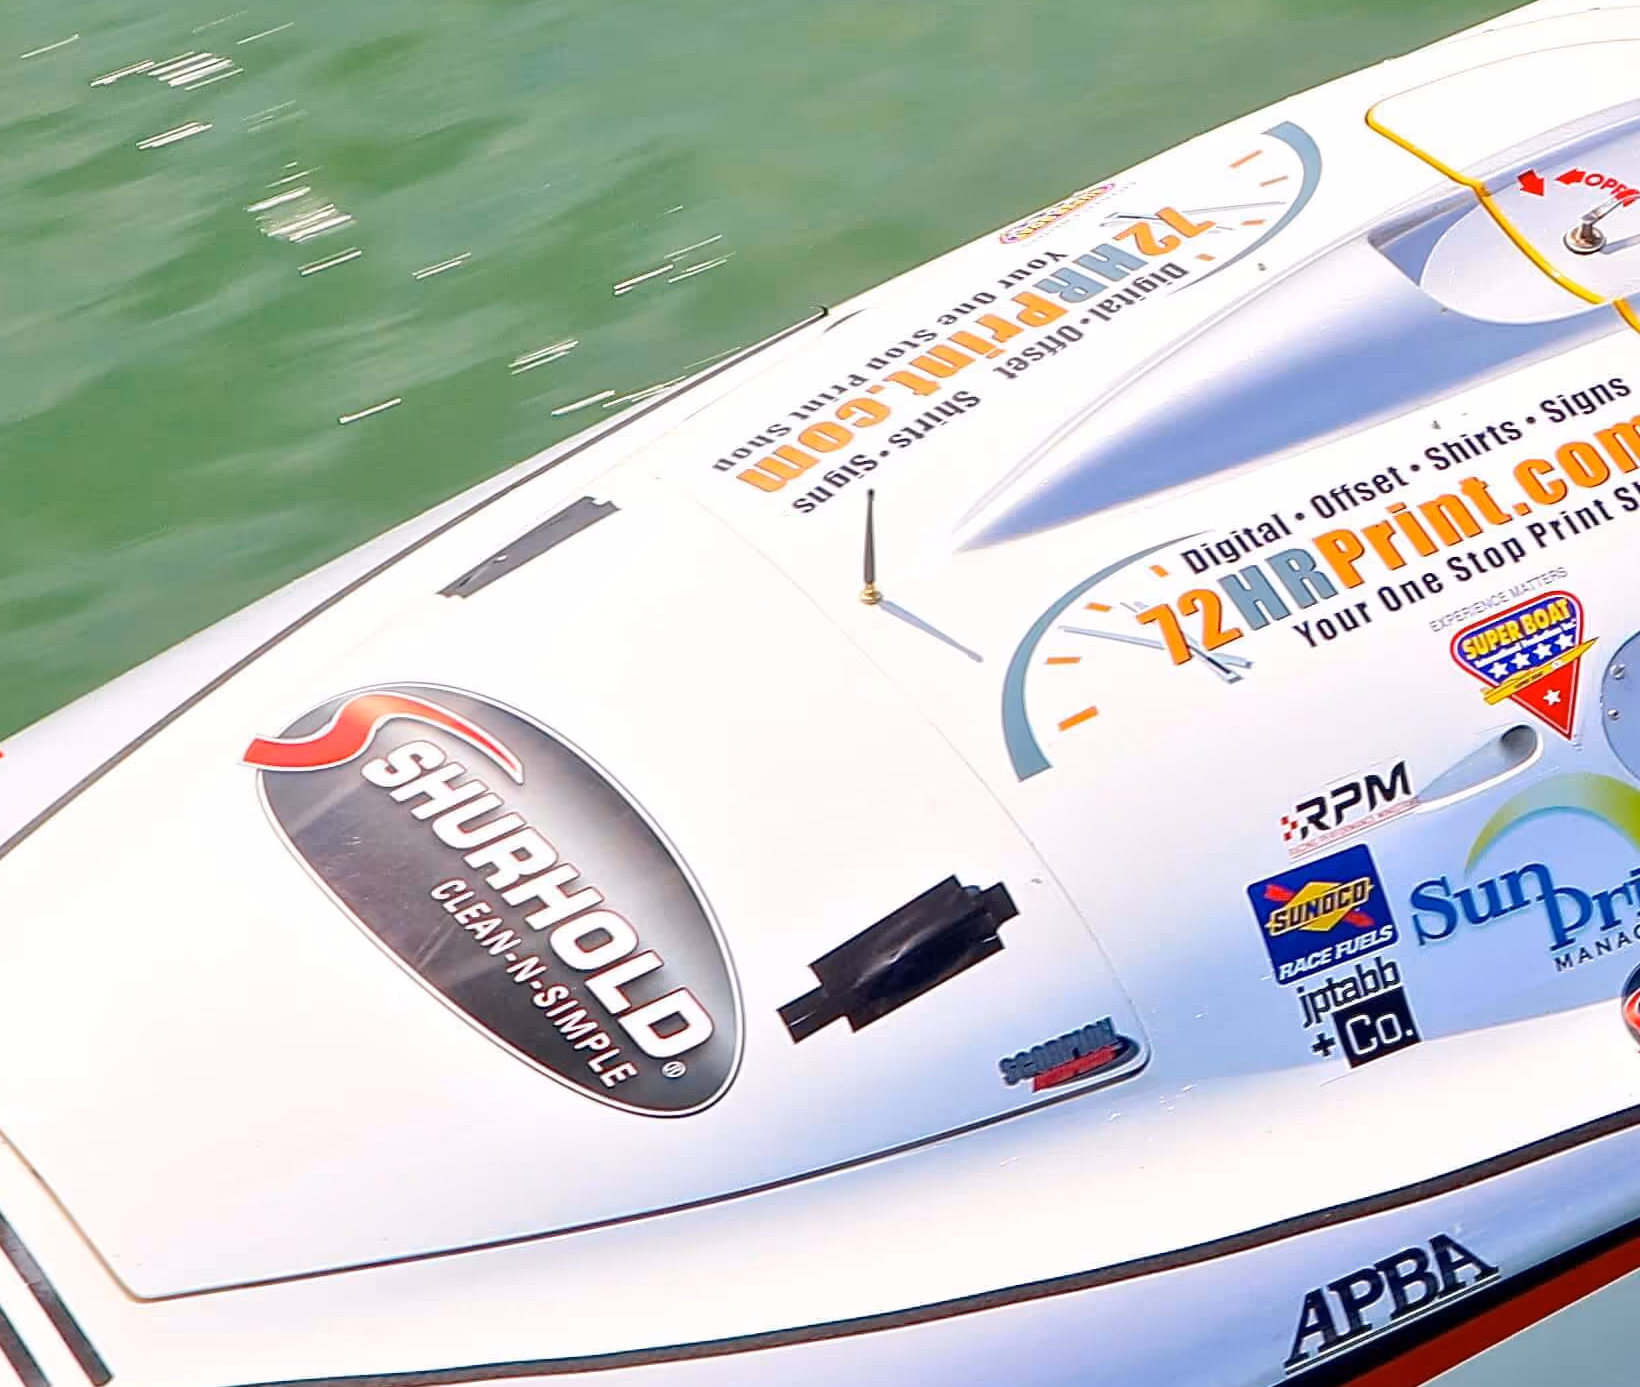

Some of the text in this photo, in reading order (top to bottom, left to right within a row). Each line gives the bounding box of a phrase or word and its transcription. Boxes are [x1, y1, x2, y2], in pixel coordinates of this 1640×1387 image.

[711, 250, 1070, 472] Your One Stop Print Shop
[735, 207, 1217, 493] 72HRPrint.com
[792, 262, 1189, 514] Digital Offset Shirts Signs
[1180, 377, 1632, 575] Digital Offset Shirts Signs
[1292, 600, 1373, 648] Your
[1377, 572, 1444, 613] One
[1446, 536, 1527, 583] Stop
[1527, 498, 1615, 549] Print
[1428, 566, 1569, 633] EXPERIENCE MATTERS
[1461, 618, 1522, 660] SUPER
[1519, 597, 1572, 633] BOAT
[1296, 759, 1413, 840] RPM
[360, 738, 716, 1059] SHURHOLD
[1270, 880, 1371, 933] SUNOCO
[1278, 924, 1395, 981] RACE FUELS
[430, 877, 639, 1088] CLEAN-N-SIMPLE
[1344, 1013, 1415, 1056] Co.
[1284, 1232, 1498, 1369] APBA
